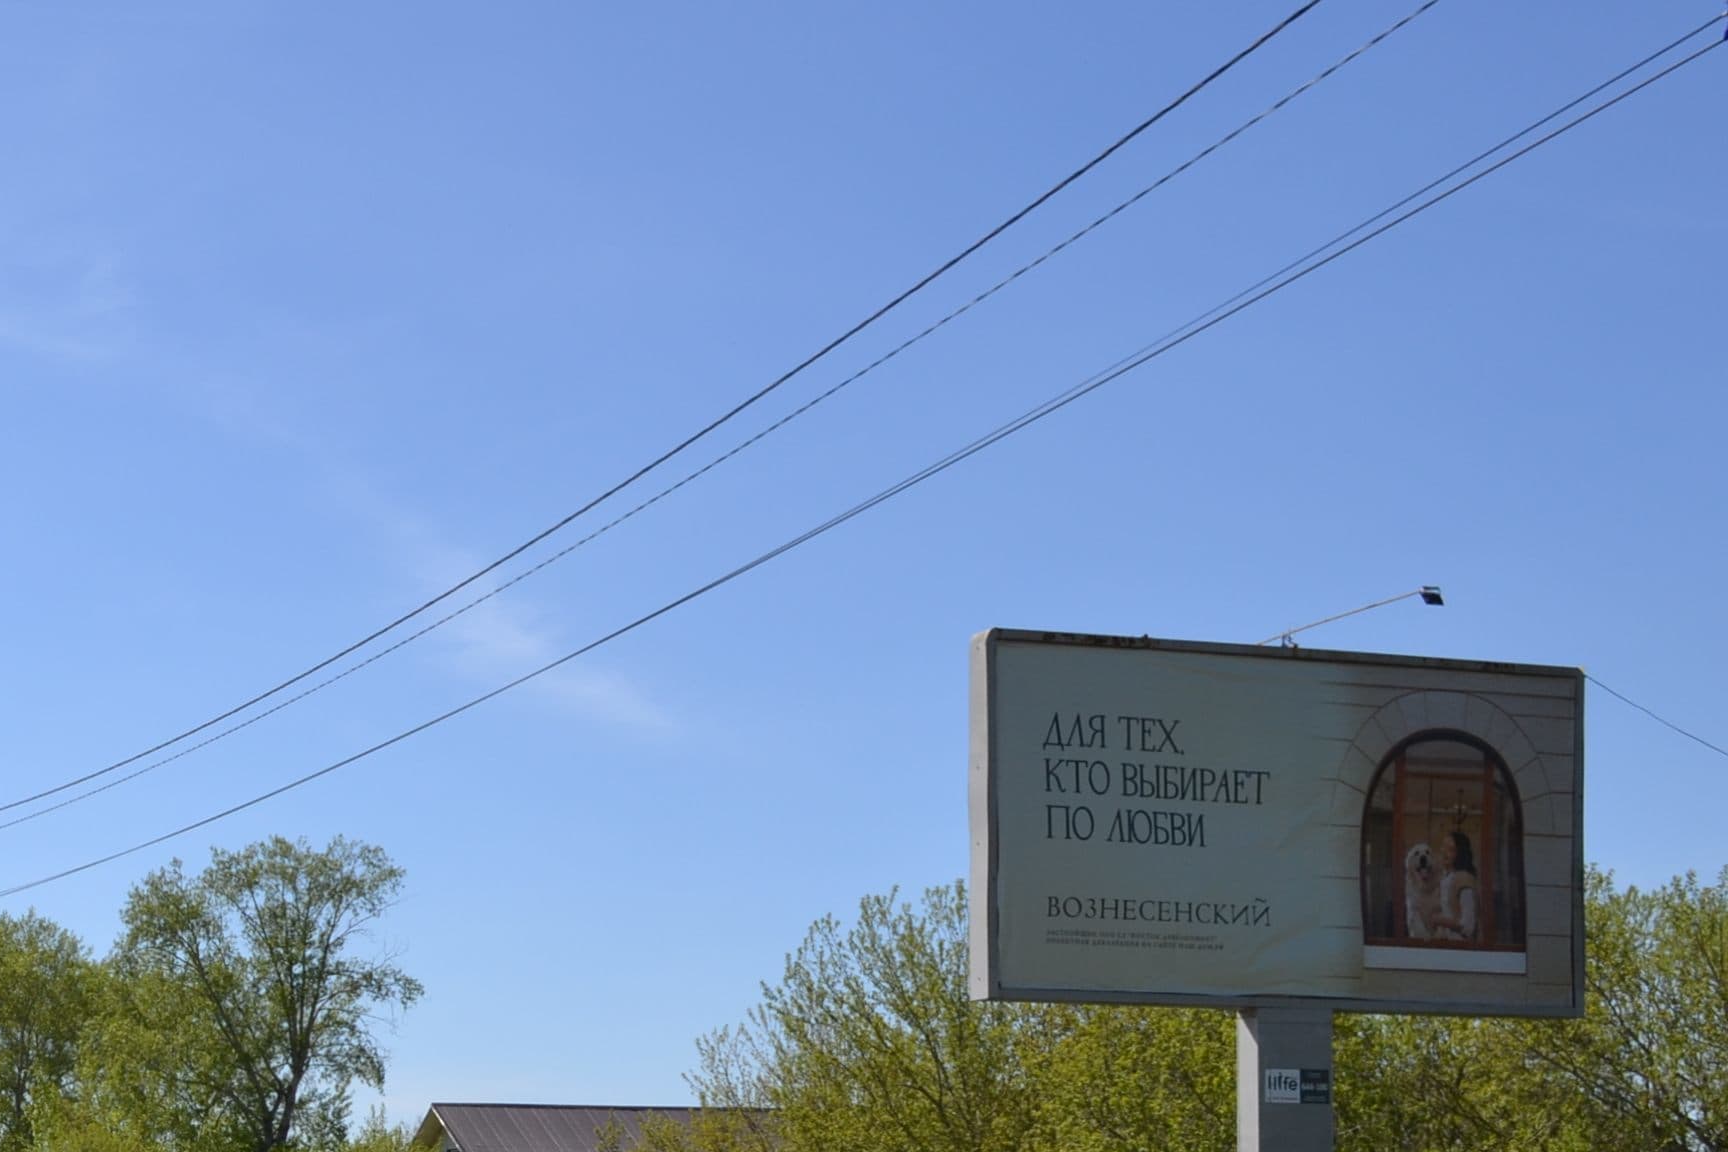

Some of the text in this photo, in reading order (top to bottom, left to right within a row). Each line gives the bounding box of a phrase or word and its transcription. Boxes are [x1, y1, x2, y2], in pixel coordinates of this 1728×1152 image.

[1042, 712, 1106, 751] ДЛЯ
[1043, 758, 1271, 805] КТО ВЫБИРАЕТ
[1045, 804, 1207, 848] ПО ЛЮБВИ
[1046, 896, 1272, 927] ВОЗНЕСЕНСКИЙ
